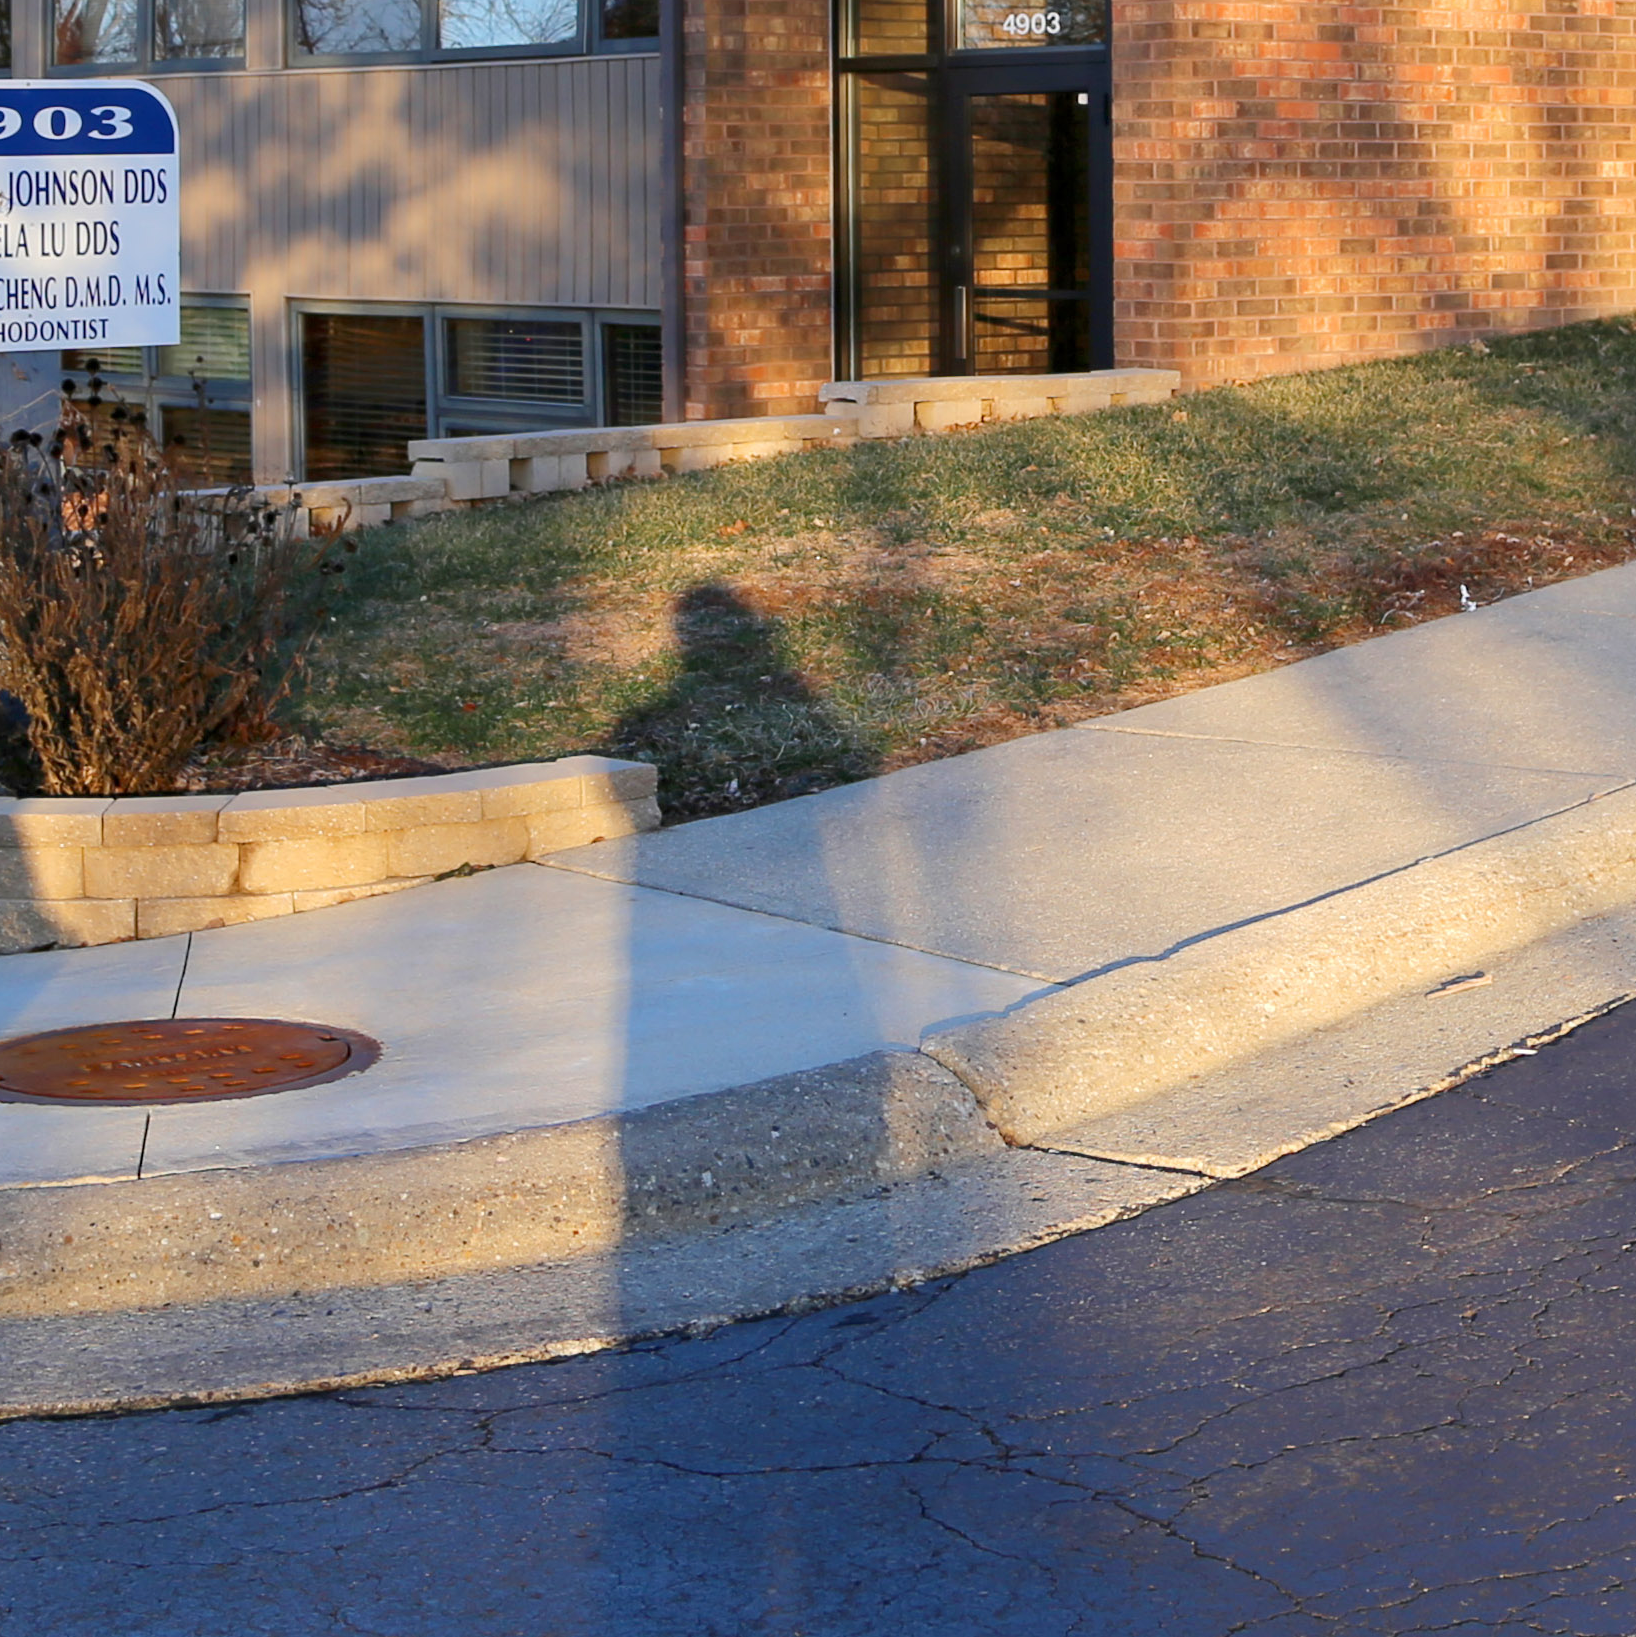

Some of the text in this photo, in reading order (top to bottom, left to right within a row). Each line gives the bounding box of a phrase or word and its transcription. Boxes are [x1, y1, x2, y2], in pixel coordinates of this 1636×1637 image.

[1003, 12, 1061, 35] 4903
[7, 169, 114, 214] JOHNSON
[124, 168, 167, 204] DDS
[41, 222, 65, 257] LU
[77, 221, 121, 256] DDS
[65, 275, 126, 308] D.M.D.
[134, 273, 171, 305] M.S.
